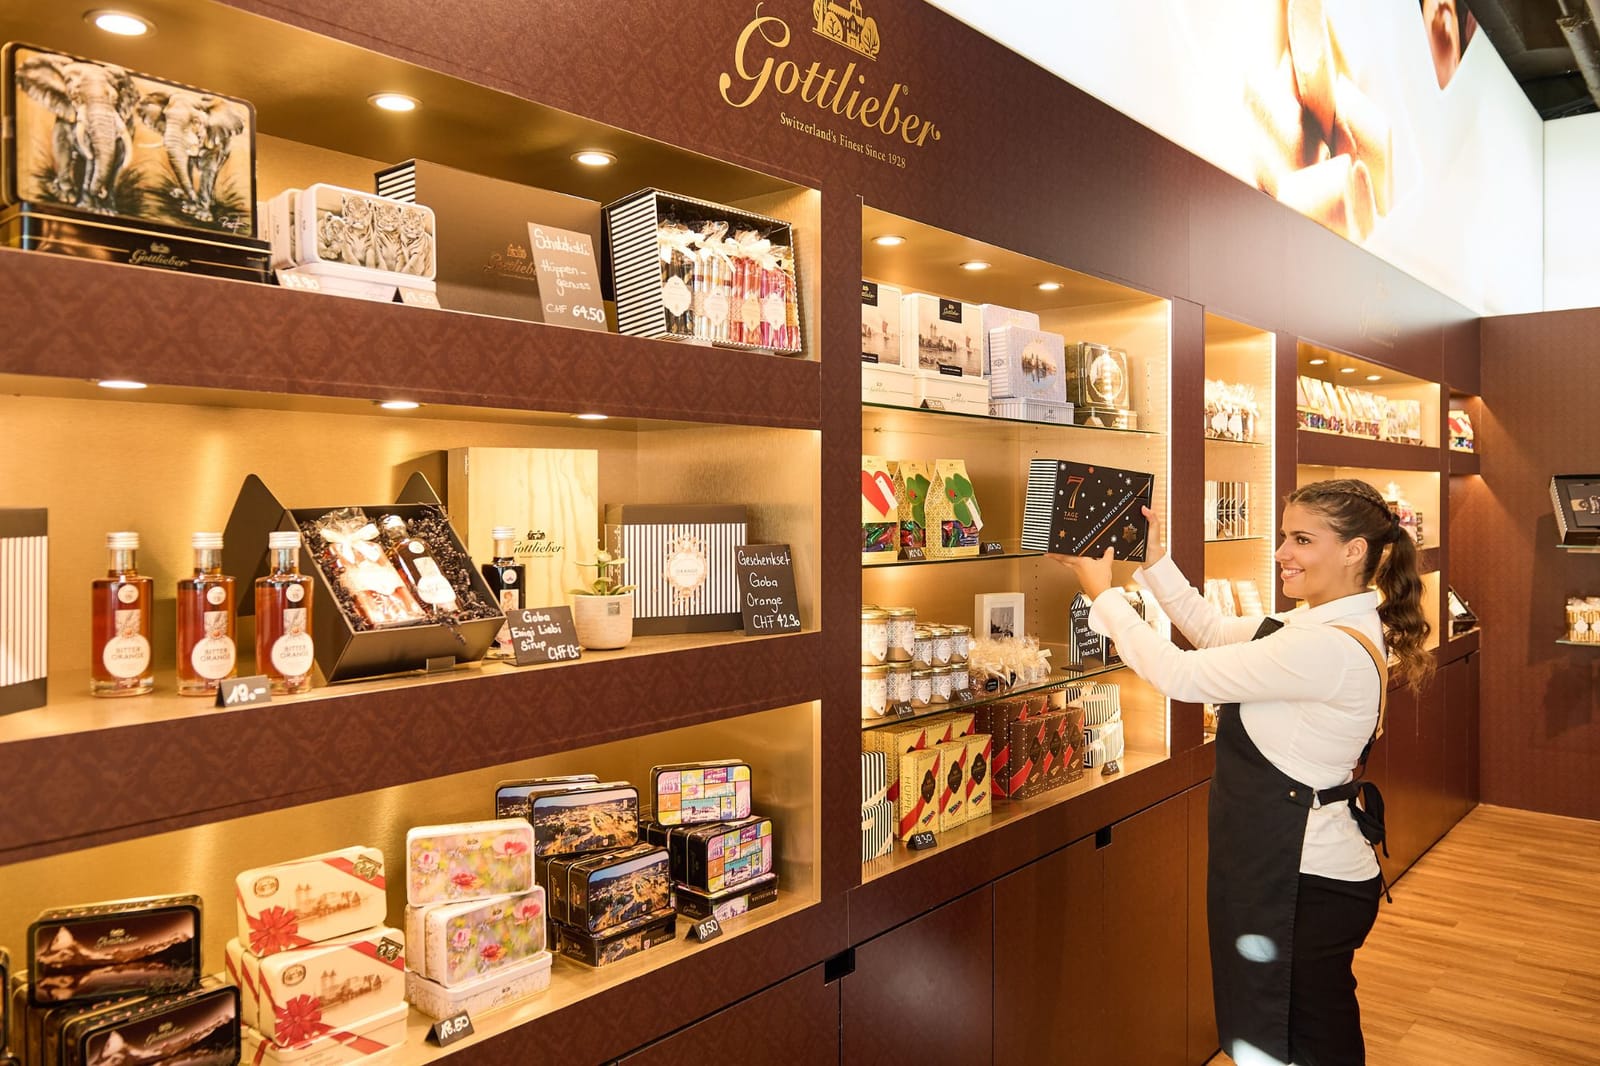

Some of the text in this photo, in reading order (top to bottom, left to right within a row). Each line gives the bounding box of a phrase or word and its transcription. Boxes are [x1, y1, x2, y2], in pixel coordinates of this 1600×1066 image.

[780, 112, 907, 169] Switzerland's Finest Since 1928
[546, 304, 568, 314] CHF
[1067, 475, 1085, 509] 7
[737, 550, 791, 566] Geschenkset
[749, 572, 778, 588] Goba
[747, 593, 783, 613] Orange
[522, 611, 551, 623] Goba
[753, 615, 775, 629] CHF
